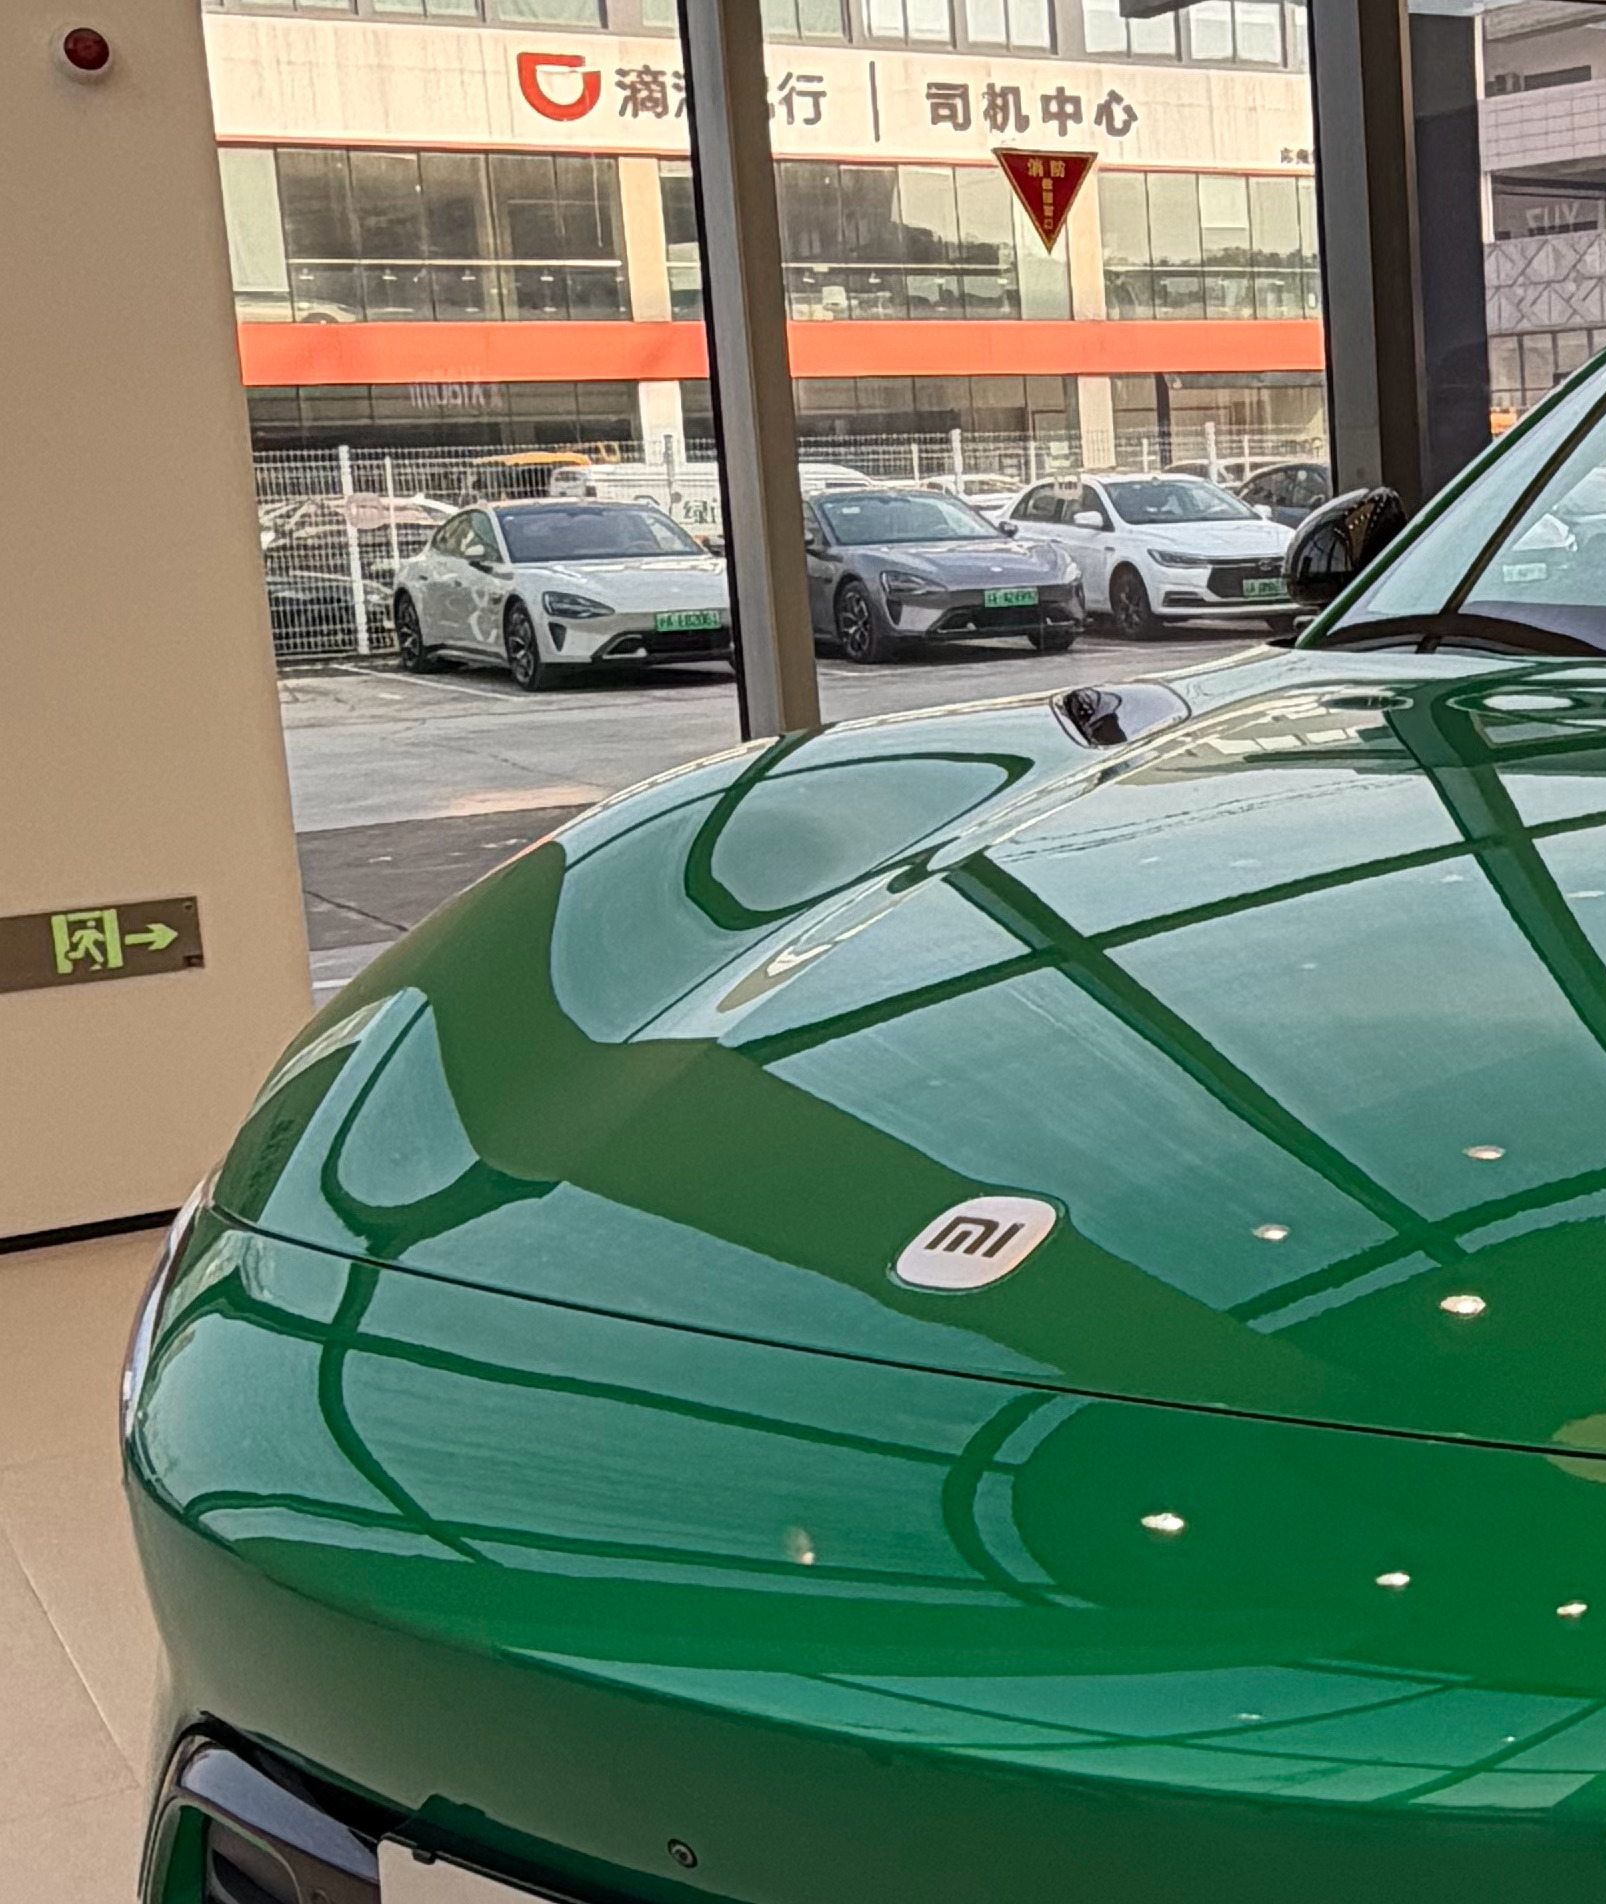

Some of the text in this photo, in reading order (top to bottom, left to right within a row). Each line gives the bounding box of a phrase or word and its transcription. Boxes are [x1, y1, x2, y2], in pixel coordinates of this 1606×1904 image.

[614, 64, 1138, 137] 滴行 司机中心
